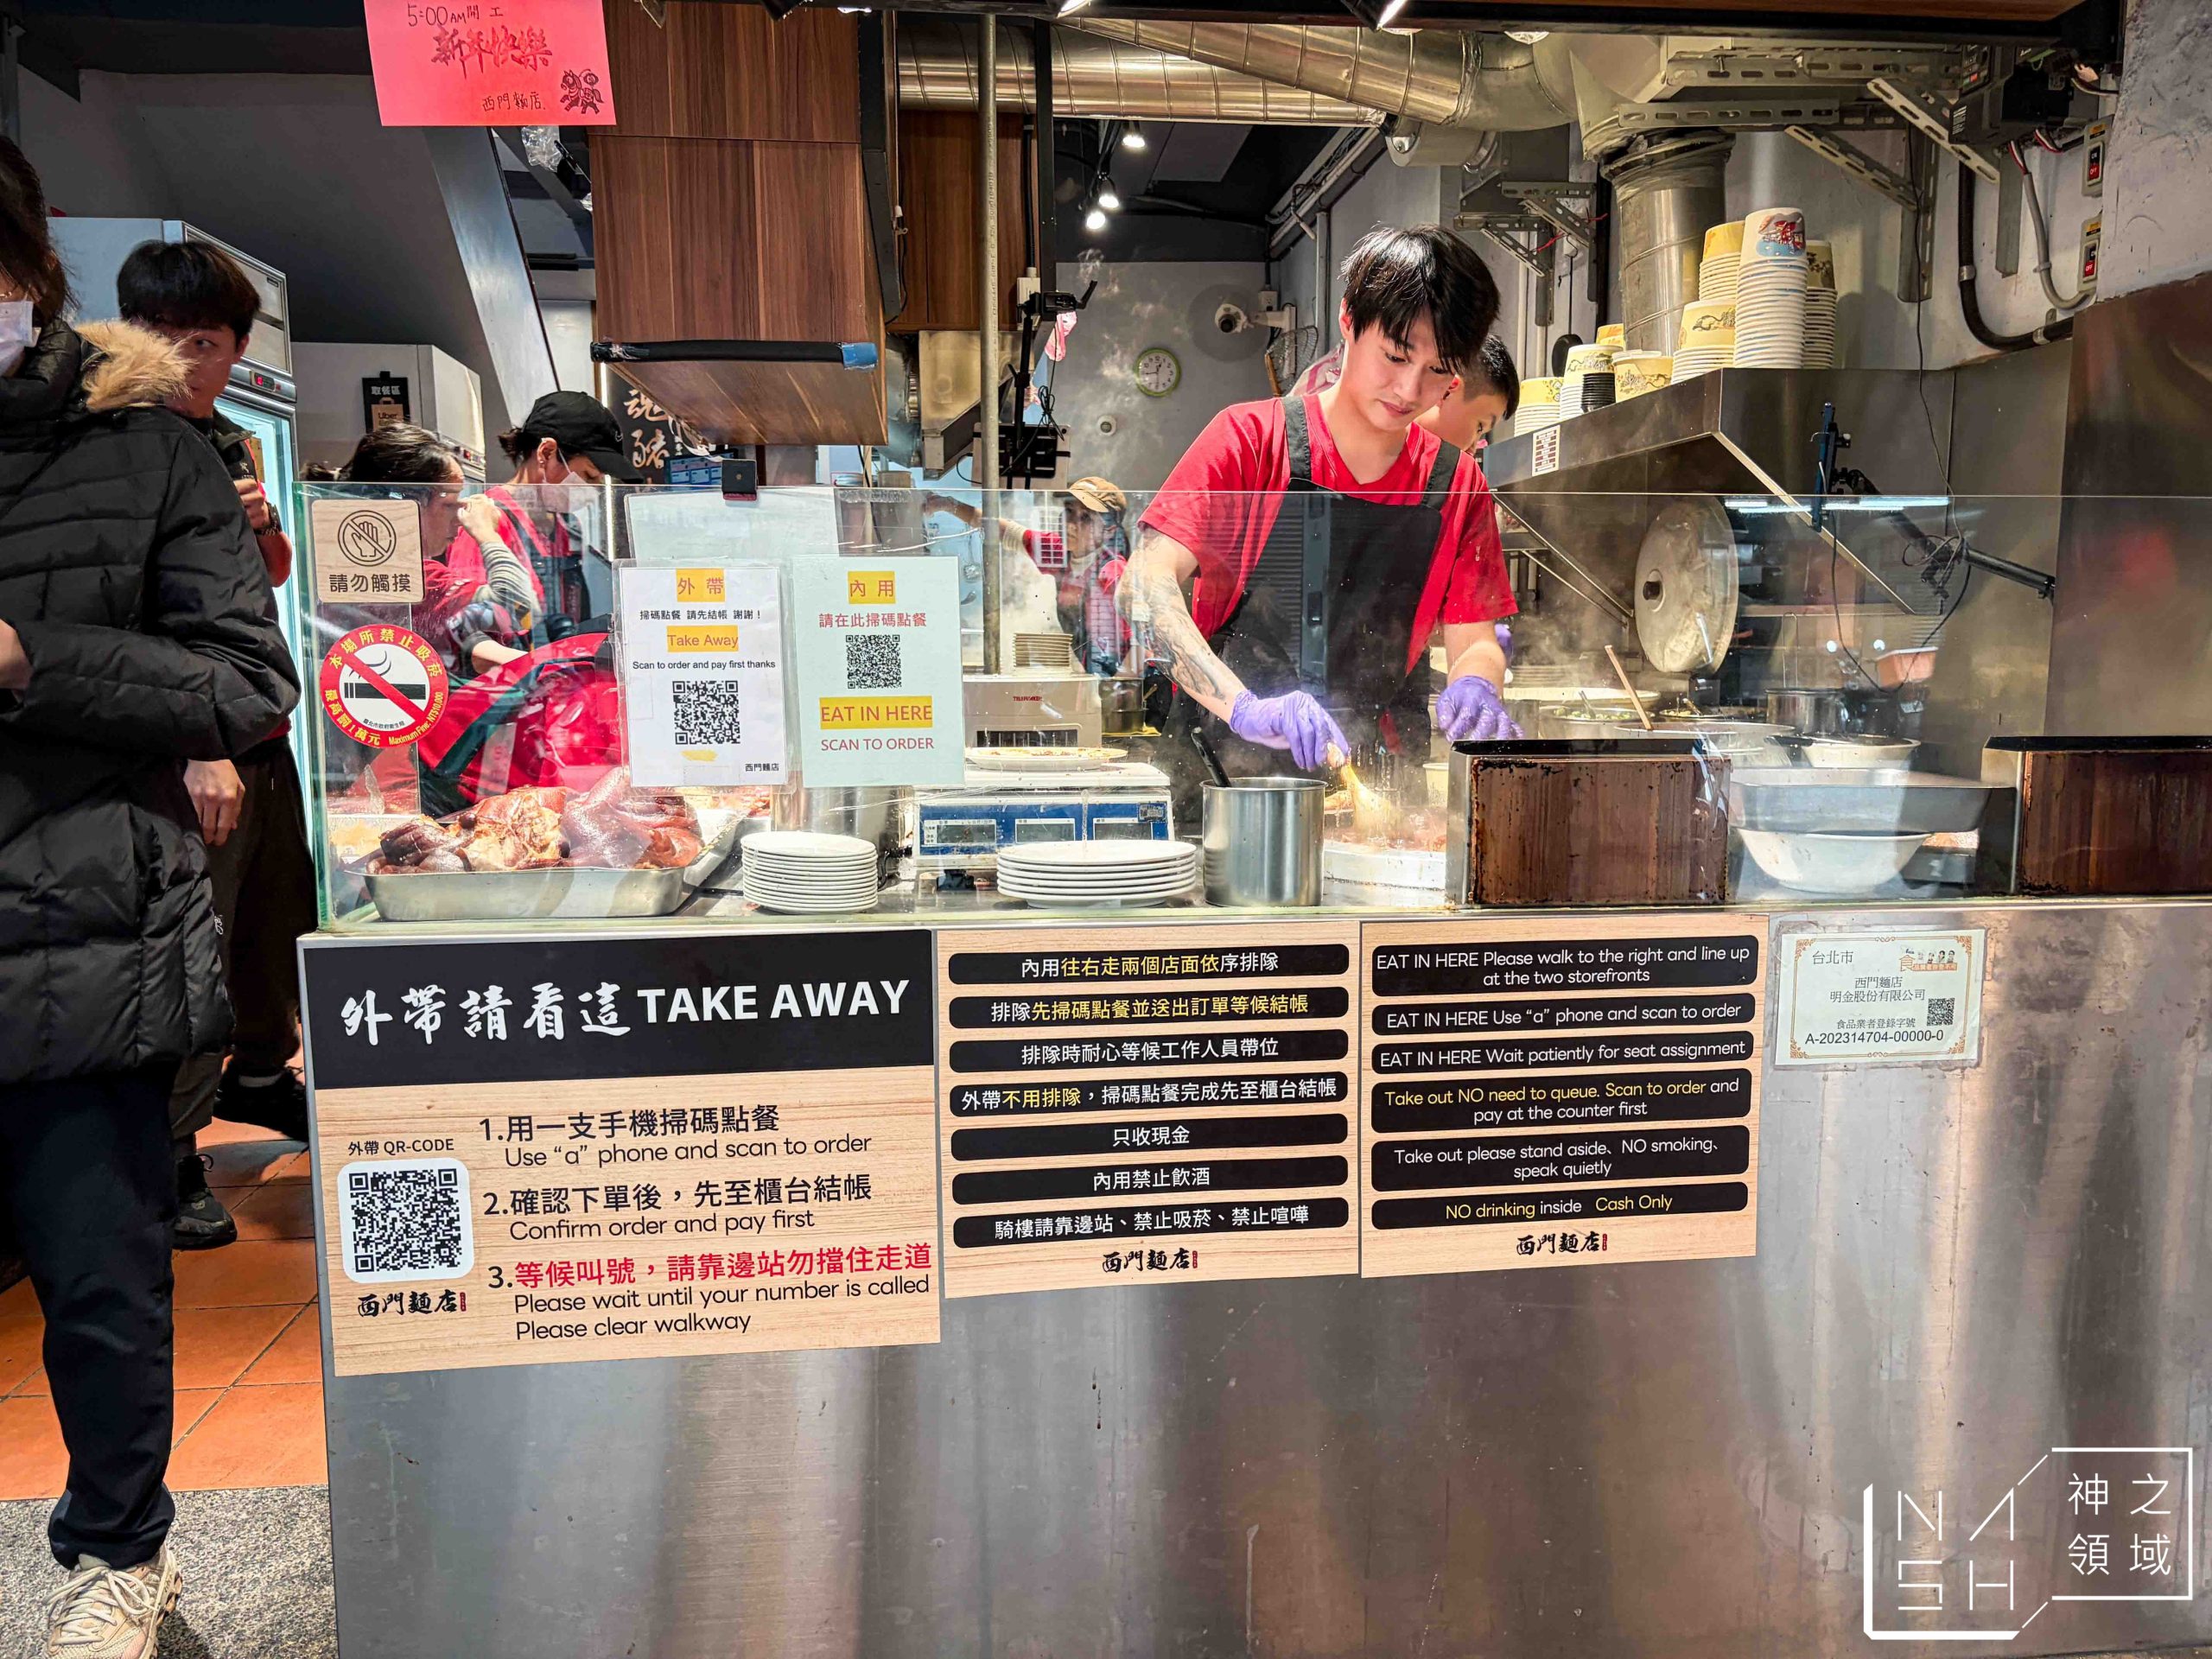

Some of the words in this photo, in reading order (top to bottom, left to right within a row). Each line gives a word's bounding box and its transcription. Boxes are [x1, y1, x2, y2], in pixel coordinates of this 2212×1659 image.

[329, 574, 410, 593] 請勿觸摸
[640, 611, 681, 620] 掃碼點餐
[687, 610, 727, 620] 請先結帳
[819, 613, 926, 628] 請在此掃碼點餐
[667, 634, 699, 646] Take
[703, 634, 738, 648] Away
[633, 661, 654, 670] Scan
[711, 662, 727, 671] pay
[822, 707, 855, 721] EAT
[861, 706, 879, 721] IN
[887, 705, 931, 721] HERE
[389, 731, 419, 745] Maximum
[822, 739, 859, 751] SCAN
[863, 739, 882, 750] TO
[887, 738, 934, 750] ORDER
[1021, 953, 1278, 977] 內用往右走兩個店面依序排隊
[1377, 955, 1411, 969] EAT
[1414, 954, 1430, 968] IN
[1435, 952, 1478, 967] HERE
[1484, 950, 1533, 966] Please
[1538, 950, 1573, 964] walk
[1579, 950, 1594, 963] to
[1599, 949, 1624, 963] the
[1629, 947, 1662, 964] right
[1668, 946, 1696, 961] and
[1701, 945, 1726, 960] line
[1731, 948, 1750, 963] up
[1813, 950, 1853, 964] 台北市
[1484, 973, 1500, 985] at
[1504, 971, 1529, 985] the
[1534, 971, 1563, 984] two
[1568, 968, 1650, 983] storefronts
[1830, 989, 1925, 1002] 明金股份有限公司
[341, 982, 631, 1046] 外帶請看這
[638, 985, 758, 1024] TAKE
[770, 980, 910, 1018] AWAY
[991, 995, 1308, 1021] 排隊先掃碼點餐並送出訂單等候結帳
[1387, 1014, 1420, 1028] EAT
[1424, 1012, 1440, 1027] IN
[1446, 1010, 1488, 1026] HERE
[1493, 1010, 1521, 1024] Use
[1555, 1007, 1603, 1026] phone
[1608, 1005, 1637, 1020] and
[1642, 1007, 1677, 1019] scan
[1681, 1005, 1697, 1017] to
[1702, 1002, 1741, 1017] order
[1836, 1018, 1916, 1029] 食品業者登錄字號
[1806, 1030, 1943, 1044] A-202314704-00000-0
[1021, 1038, 1279, 1065] 排隊時耐心等候工作人員帶位
[1381, 1052, 1413, 1067] EAT
[1417, 1051, 1433, 1065] IN
[1439, 1049, 1481, 1065] HERE
[1486, 1048, 1523, 1063] Wait
[1529, 1045, 1593, 1065] patiently
[1598, 1044, 1619, 1058] for
[1624, 1044, 1656, 1058] seat
[1661, 1040, 1745, 1058] assignment
[1385, 1091, 1423, 1106] Take
[1428, 1090, 1453, 1104] out
[1459, 1088, 1484, 1103] NO
[1489, 1086, 1525, 1102] need
[1530, 1087, 1546, 1101] to
[1551, 1084, 1599, 1101] queue.
[1605, 1083, 1642, 1097] Scan
[1647, 1082, 1662, 1096] to
[1667, 1080, 1707, 1095] order
[1711, 1078, 1739, 1092] and
[1474, 1109, 1503, 1125] pay
[1508, 1107, 1523, 1121] at
[1529, 1105, 1553, 1119] the
[1557, 1103, 1614, 1118] counter
[1619, 1101, 1647, 1115] first
[348, 1141, 379, 1156] 外帶
[384, 1138, 454, 1154] QR-CODE
[1113, 1125, 1190, 1147] 只收現金
[505, 1147, 547, 1166] Use
[598, 1142, 668, 1167] phone
[675, 1140, 717, 1159] and
[726, 1141, 776, 1157] scan
[784, 1137, 806, 1155] to
[814, 1134, 872, 1154] order
[1395, 1148, 1433, 1164] Take
[1438, 1148, 1462, 1162] out
[1467, 1145, 1516, 1164] please
[1520, 1143, 1562, 1158] stand
[1622, 1139, 1646, 1154] NO
[1094, 1166, 1210, 1191] 內用禁止飲酒
[1514, 1164, 1558, 1180] speak
[1563, 1161, 1611, 1179] quietly
[1446, 1205, 1471, 1218] NO
[1476, 1201, 1535, 1219] drinking
[1541, 1199, 1582, 1215] inside
[1596, 1197, 1634, 1211] Cash
[1639, 1195, 1673, 1212] Only
[510, 1220, 601, 1241] Confirm
[609, 1216, 667, 1236] order
[675, 1213, 716, 1233] and
[726, 1215, 766, 1236] pay
[772, 1210, 815, 1228] first
[1516, 1231, 1600, 1255] 西門麵店
[1102, 1247, 1189, 1274] 西門麵店
[358, 1289, 457, 1317] 西門麵店
[514, 1293, 585, 1313] Please
[593, 1289, 640, 1308] wait
[648, 1287, 692, 1306] until
[700, 1287, 747, 1309] your
[755, 1281, 839, 1301] number
[847, 1279, 861, 1297] is
[868, 1274, 929, 1295] called
[517, 1319, 587, 1340] Please
[594, 1316, 647, 1336] clear
[655, 1313, 751, 1334] walkway
